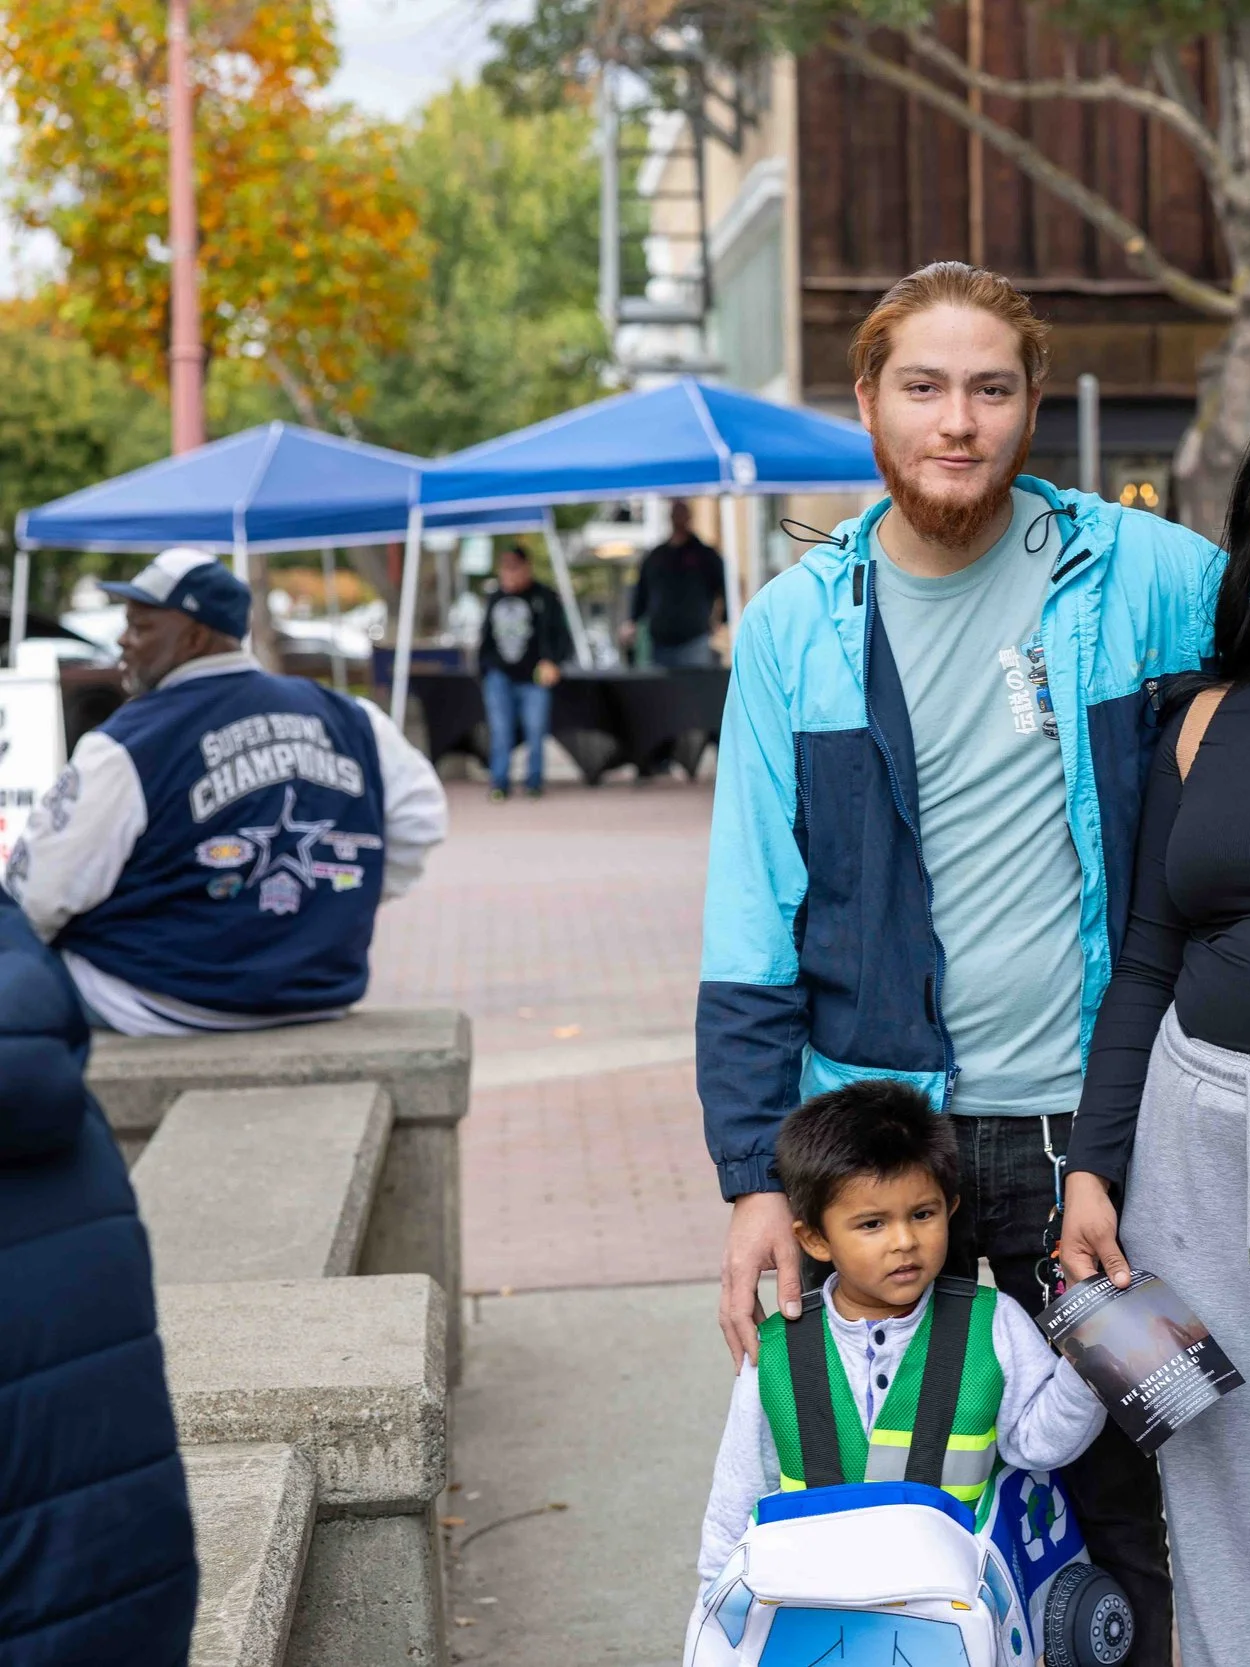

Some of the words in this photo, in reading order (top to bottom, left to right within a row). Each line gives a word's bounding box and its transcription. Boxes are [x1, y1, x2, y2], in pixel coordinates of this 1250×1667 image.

[999, 645, 1039, 734] 伝説の車
[202, 715, 271, 768] SUPER
[268, 713, 333, 749] BOWL
[189, 742, 365, 823] CHAMPIONS
[1047, 1314, 1064, 1329] THE
[1120, 1388, 1140, 1406] THE
[1139, 1364, 1171, 1389] NIGHT
[1170, 1354, 1184, 1367] OF
[1186, 1341, 1206, 1355] THE
[1140, 1375, 1173, 1403] LIVING
[1173, 1355, 1200, 1376] DEAD
[1143, 1394, 1161, 1410] OCTOBER
[1145, 1404, 1167, 1424] HALLOWEEN
[1165, 1395, 1178, 1406] NIGHT
[1153, 1392, 1172, 1409] OCTOBER
